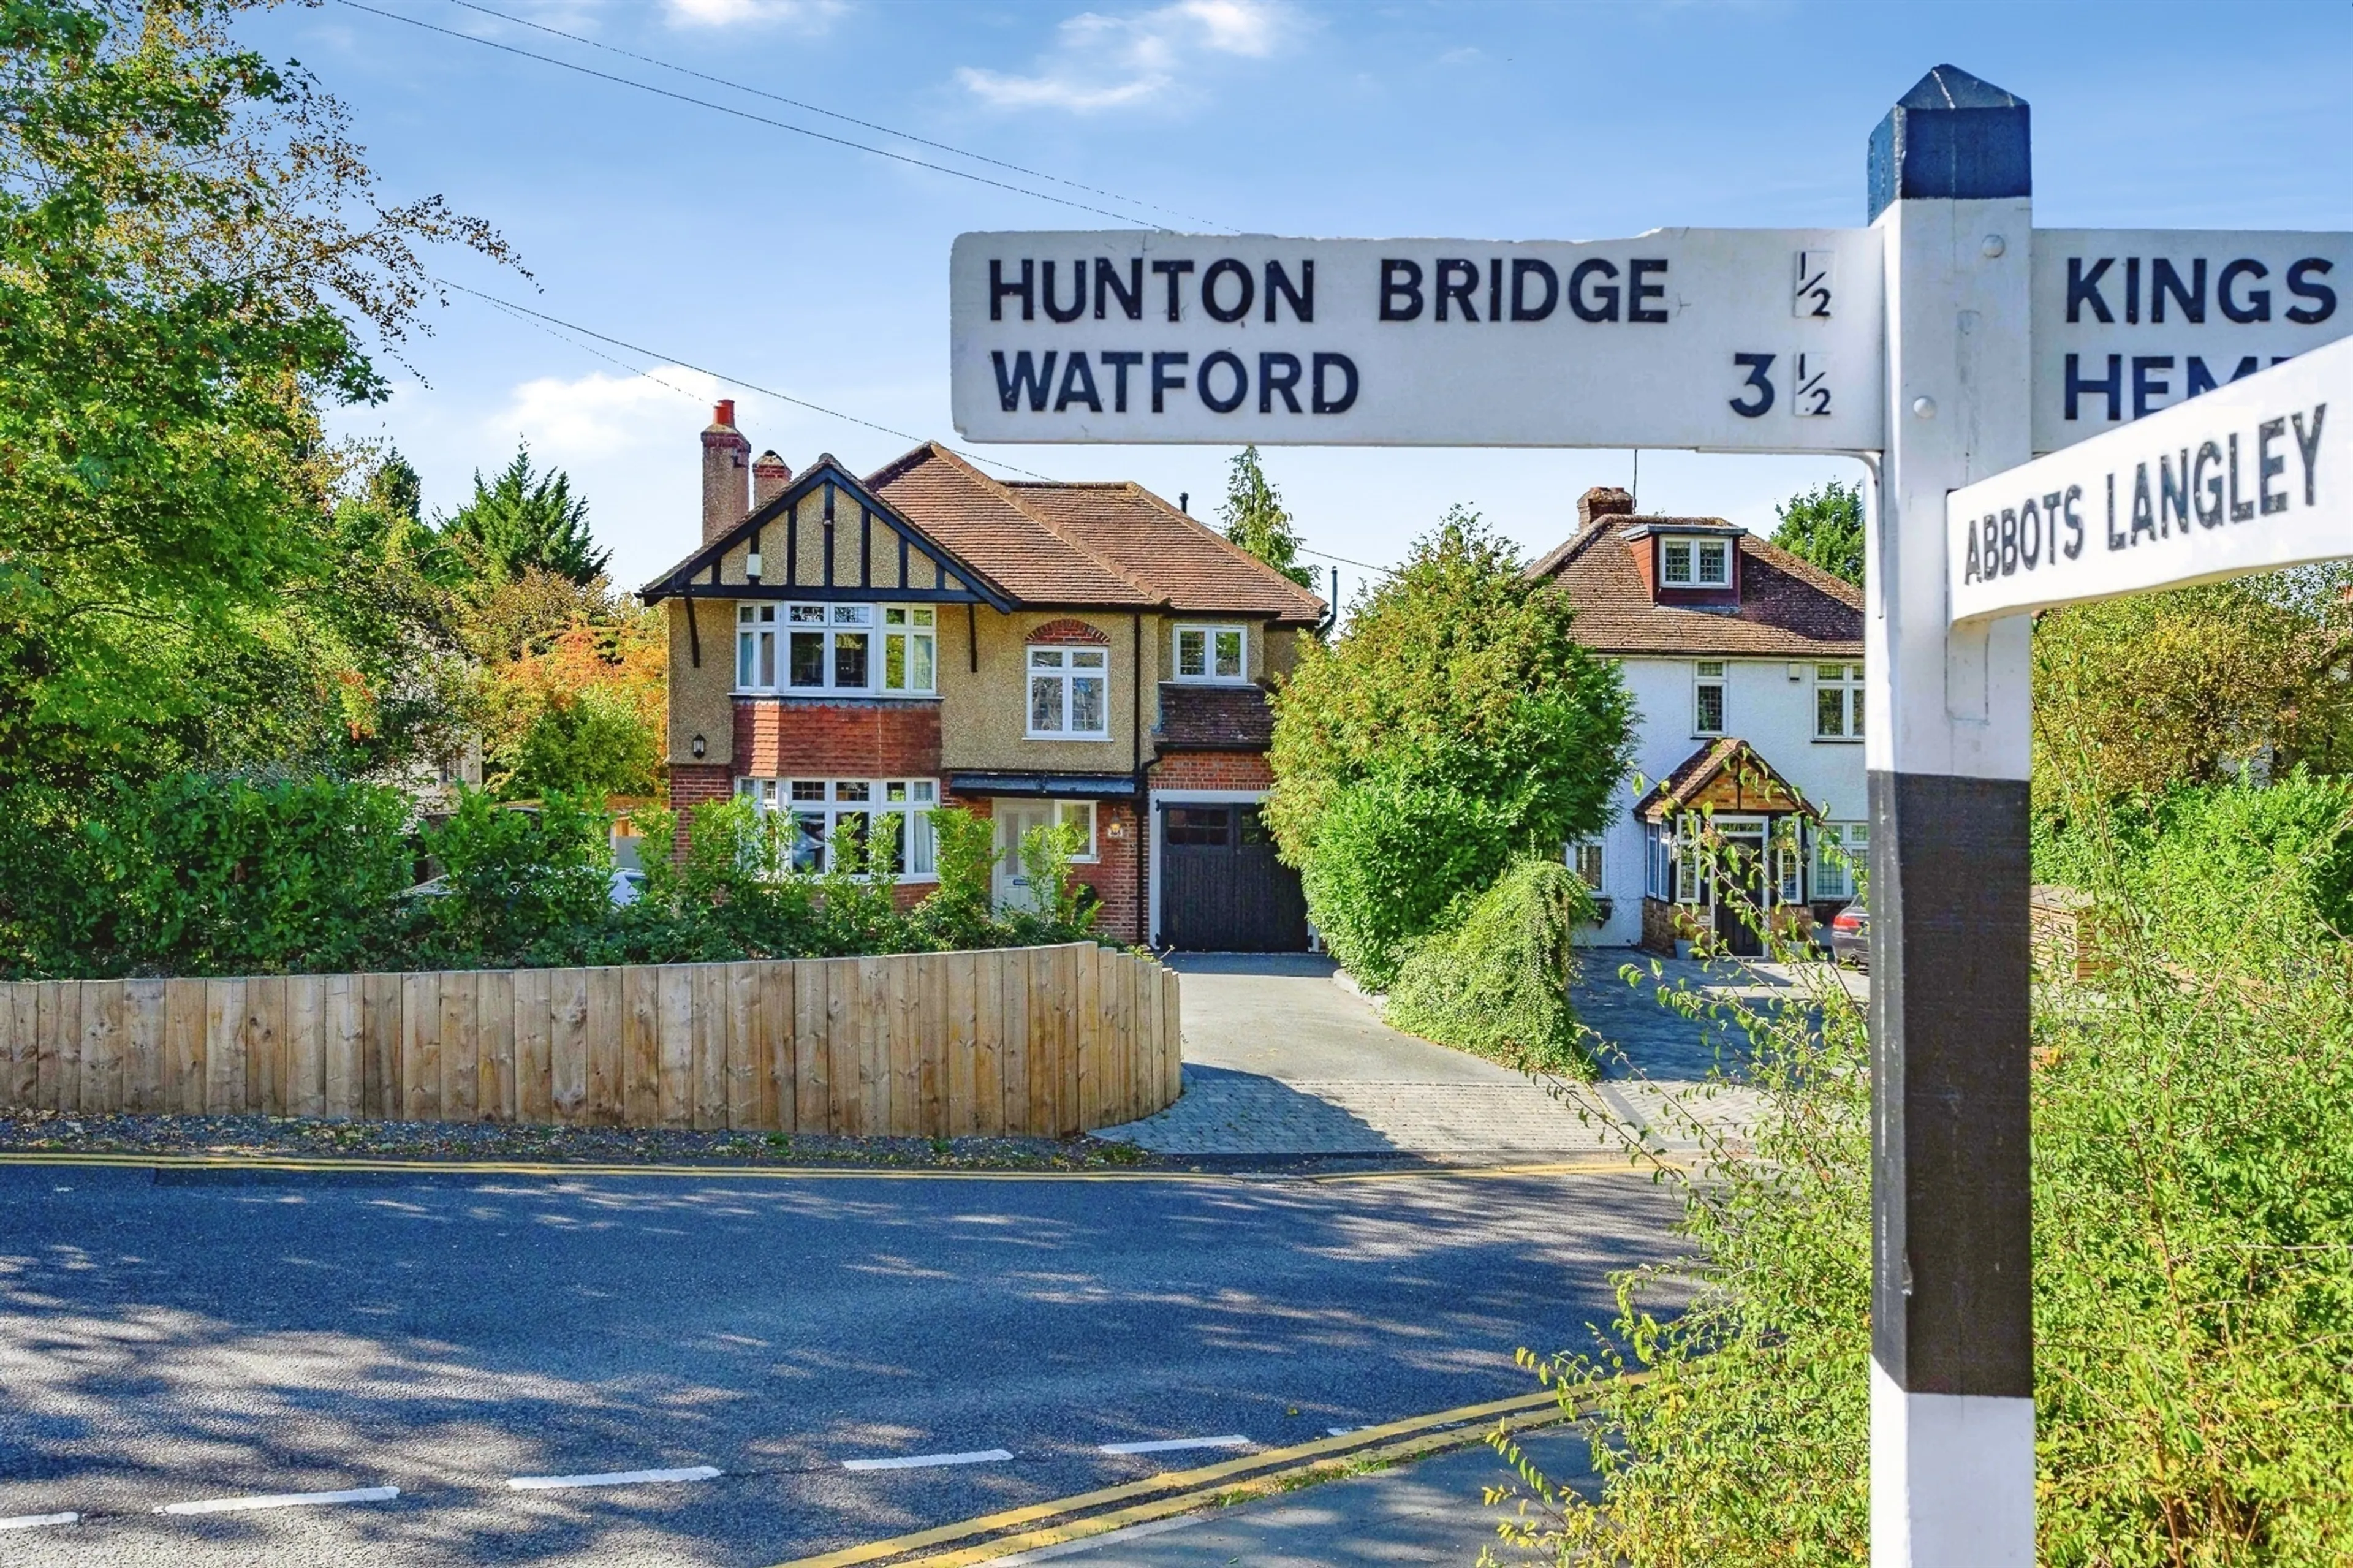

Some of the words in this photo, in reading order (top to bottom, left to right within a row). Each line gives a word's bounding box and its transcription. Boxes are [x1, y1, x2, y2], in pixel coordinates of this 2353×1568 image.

[988, 257, 1314, 324] HUNTON
[1379, 257, 1669, 324] BRIDGE
[2065, 256, 2338, 325] KINGS
[990, 350, 1360, 415] WATFORD
[1729, 352, 1777, 419] 3
[2064, 353, 2295, 421] HEM
[1964, 484, 2084, 586] ABBOTS
[2105, 402, 2327, 551] LANGLEY
